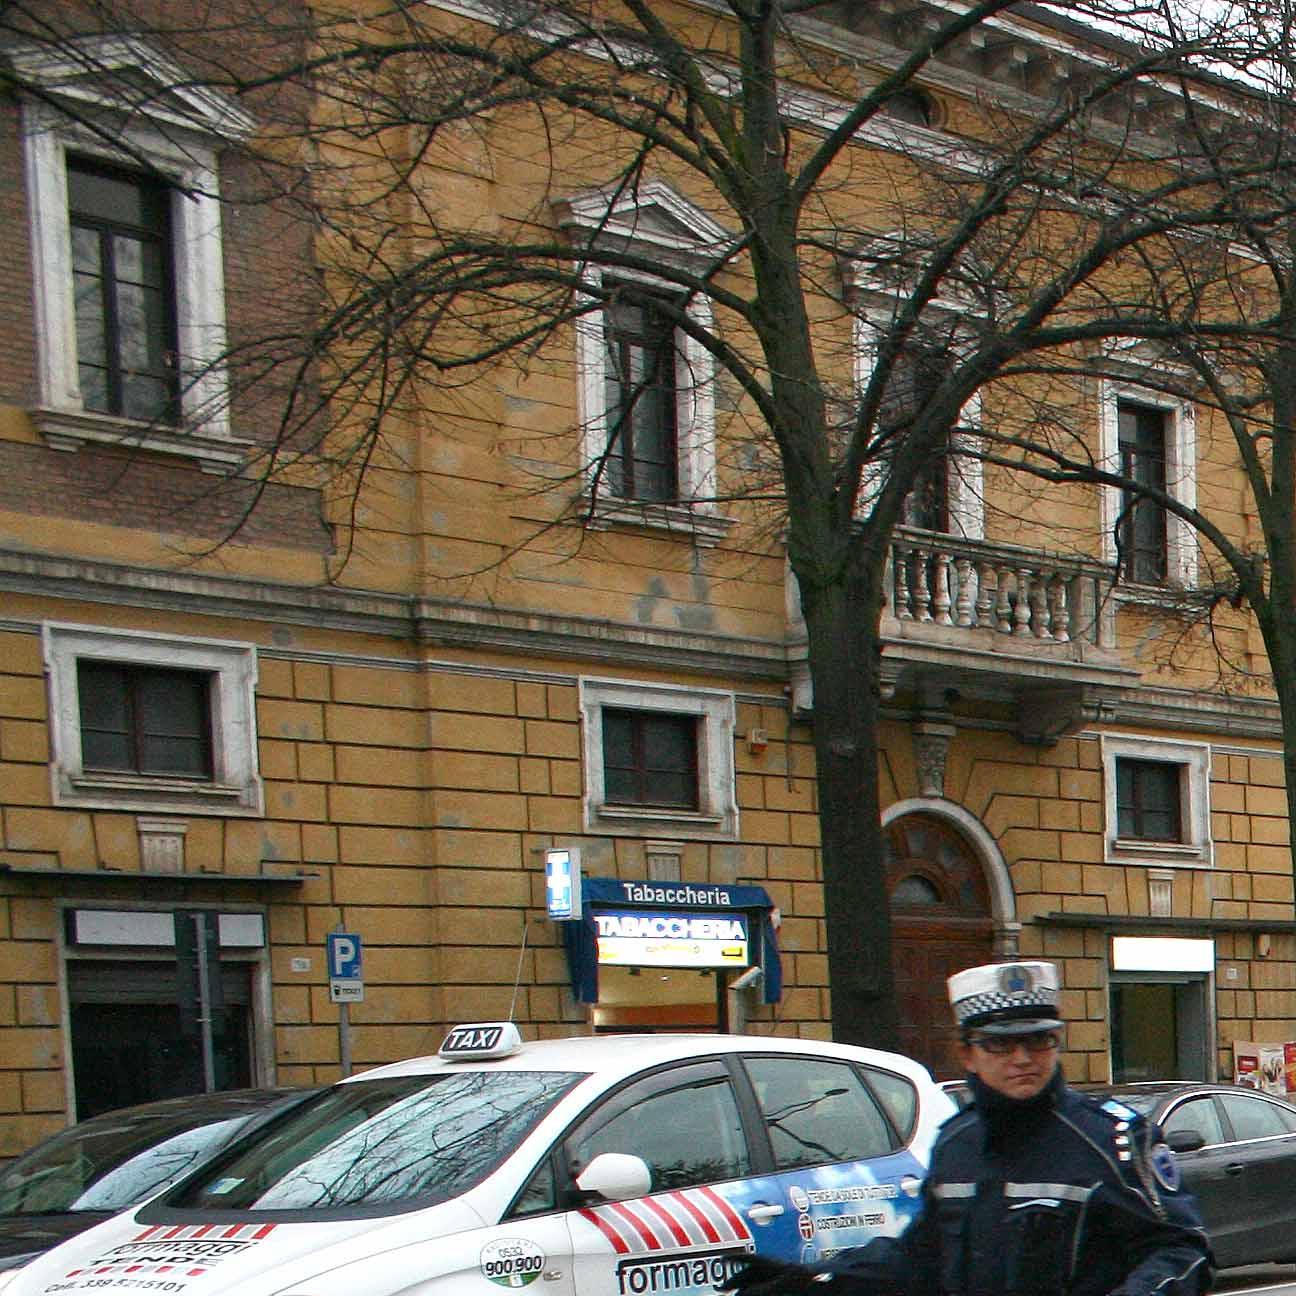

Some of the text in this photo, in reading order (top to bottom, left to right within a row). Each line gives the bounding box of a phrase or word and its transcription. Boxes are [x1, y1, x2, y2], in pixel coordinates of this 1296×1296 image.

[623, 882, 731, 905] Tabaccheria
[595, 915, 746, 940] TABACCHERIA
[333, 938, 355, 975] P
[451, 1029, 501, 1049] TAXI
[616, 1244, 756, 1296] formag
